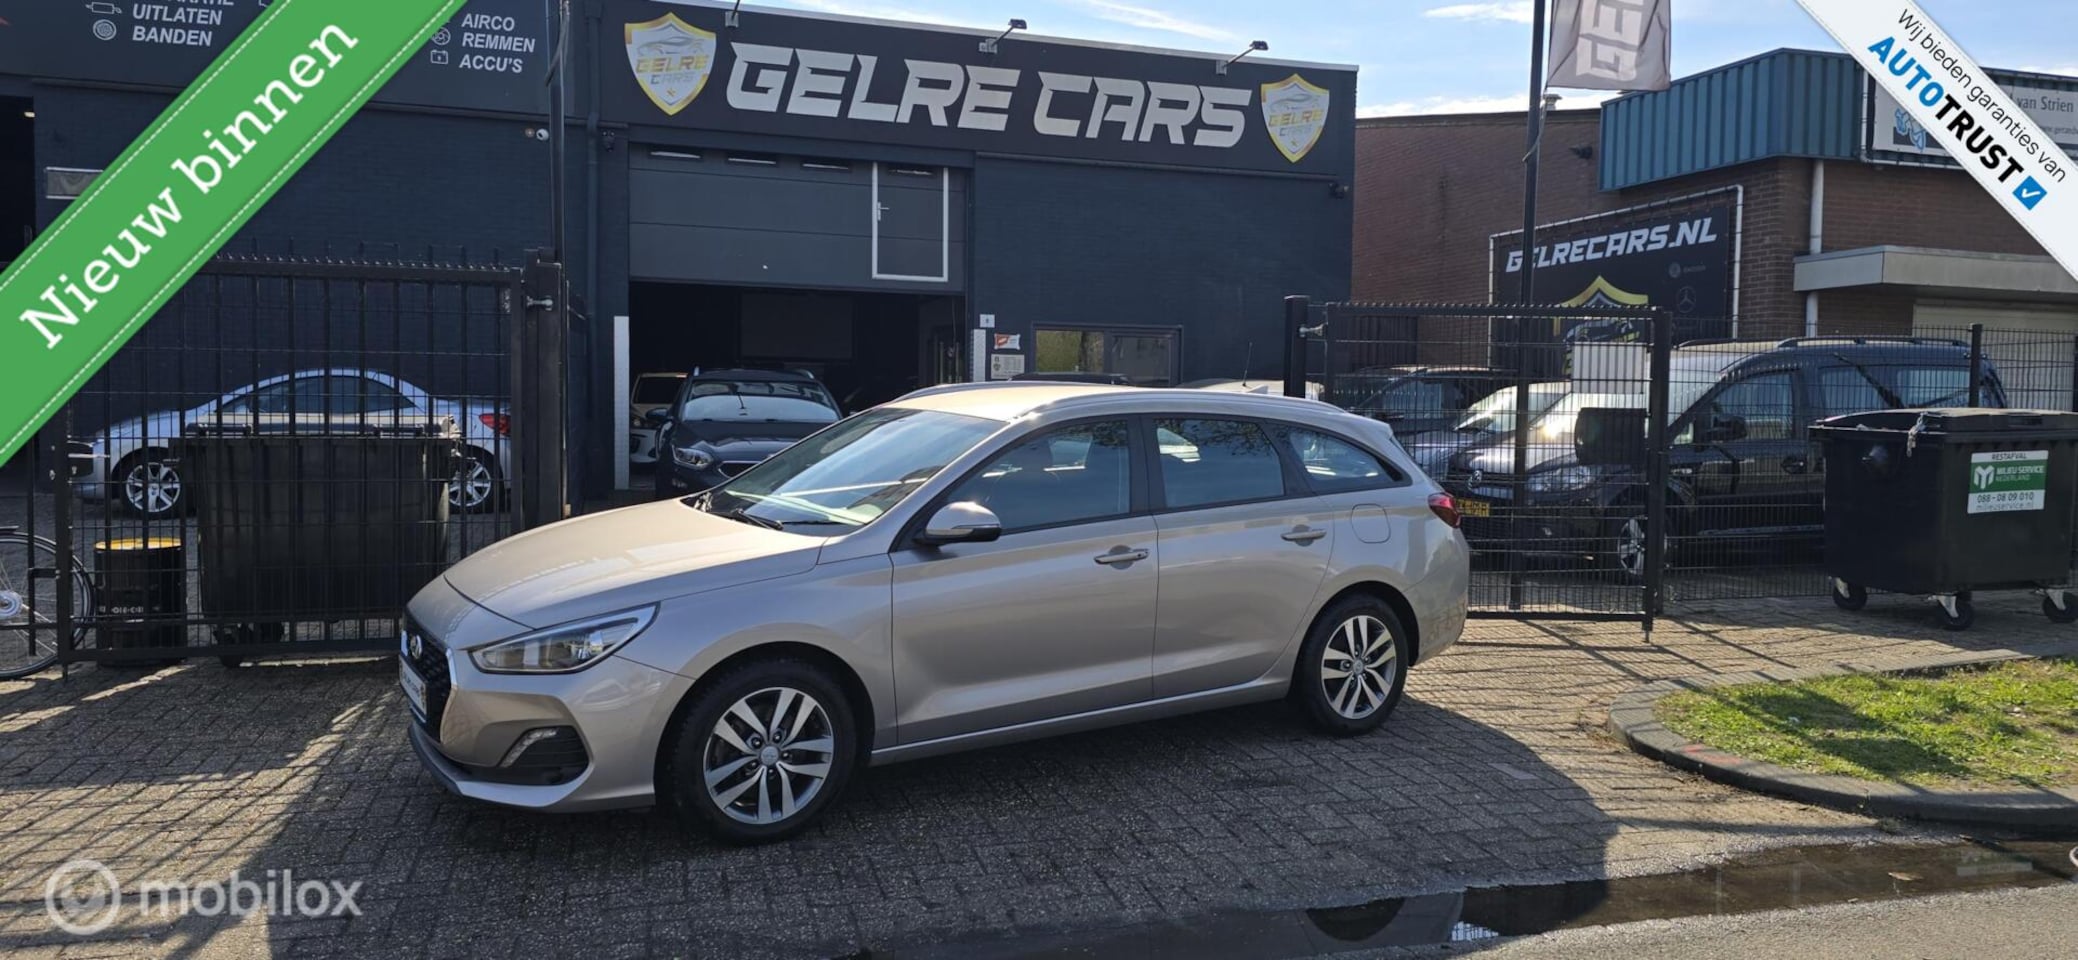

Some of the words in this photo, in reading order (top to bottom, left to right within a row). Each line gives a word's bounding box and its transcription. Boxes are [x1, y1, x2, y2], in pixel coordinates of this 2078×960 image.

[132, 4, 222, 25] UITLATEN
[461, 13, 515, 31] AIRCO
[132, 26, 212, 46] BANDEN
[462, 32, 535, 52] REMMEN
[459, 54, 523, 73] ACCU'S
[636, 55, 709, 73] GELRE
[727, 42, 1021, 132] GELRE
[1033, 72, 1253, 148] CARS
[2017, 97, 2037, 109] van
[2040, 96, 2074, 113] Strien
